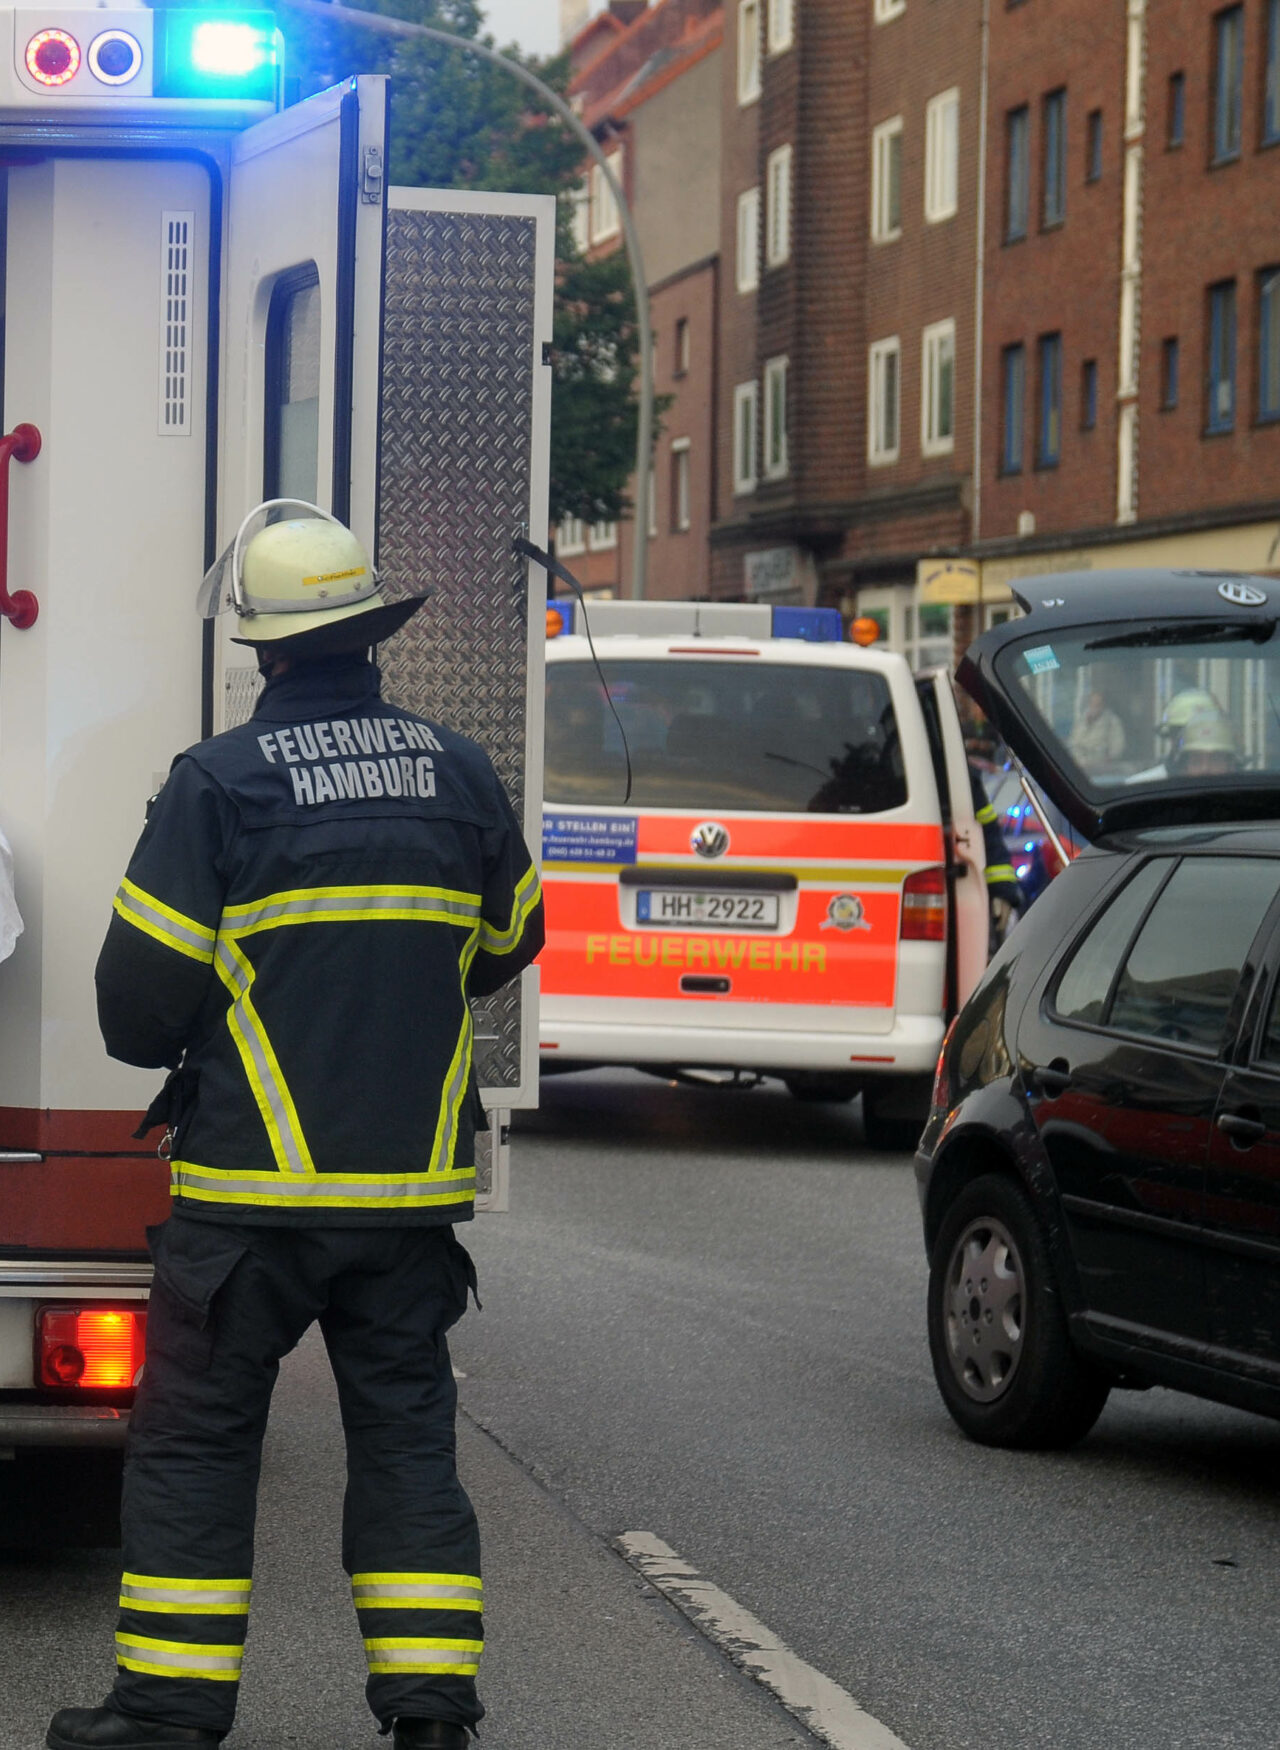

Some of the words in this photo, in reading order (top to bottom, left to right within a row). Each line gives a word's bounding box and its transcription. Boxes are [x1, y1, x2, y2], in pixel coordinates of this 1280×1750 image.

[256, 717, 445, 764] FEUERWEHR
[289, 756, 437, 806] HAMBURG
[558, 820, 607, 833] STELLEN
[610, 820, 636, 833] EIN!
[662, 895, 692, 917] HH
[707, 897, 765, 920] 2922
[585, 935, 826, 973] FEUERWEHR
